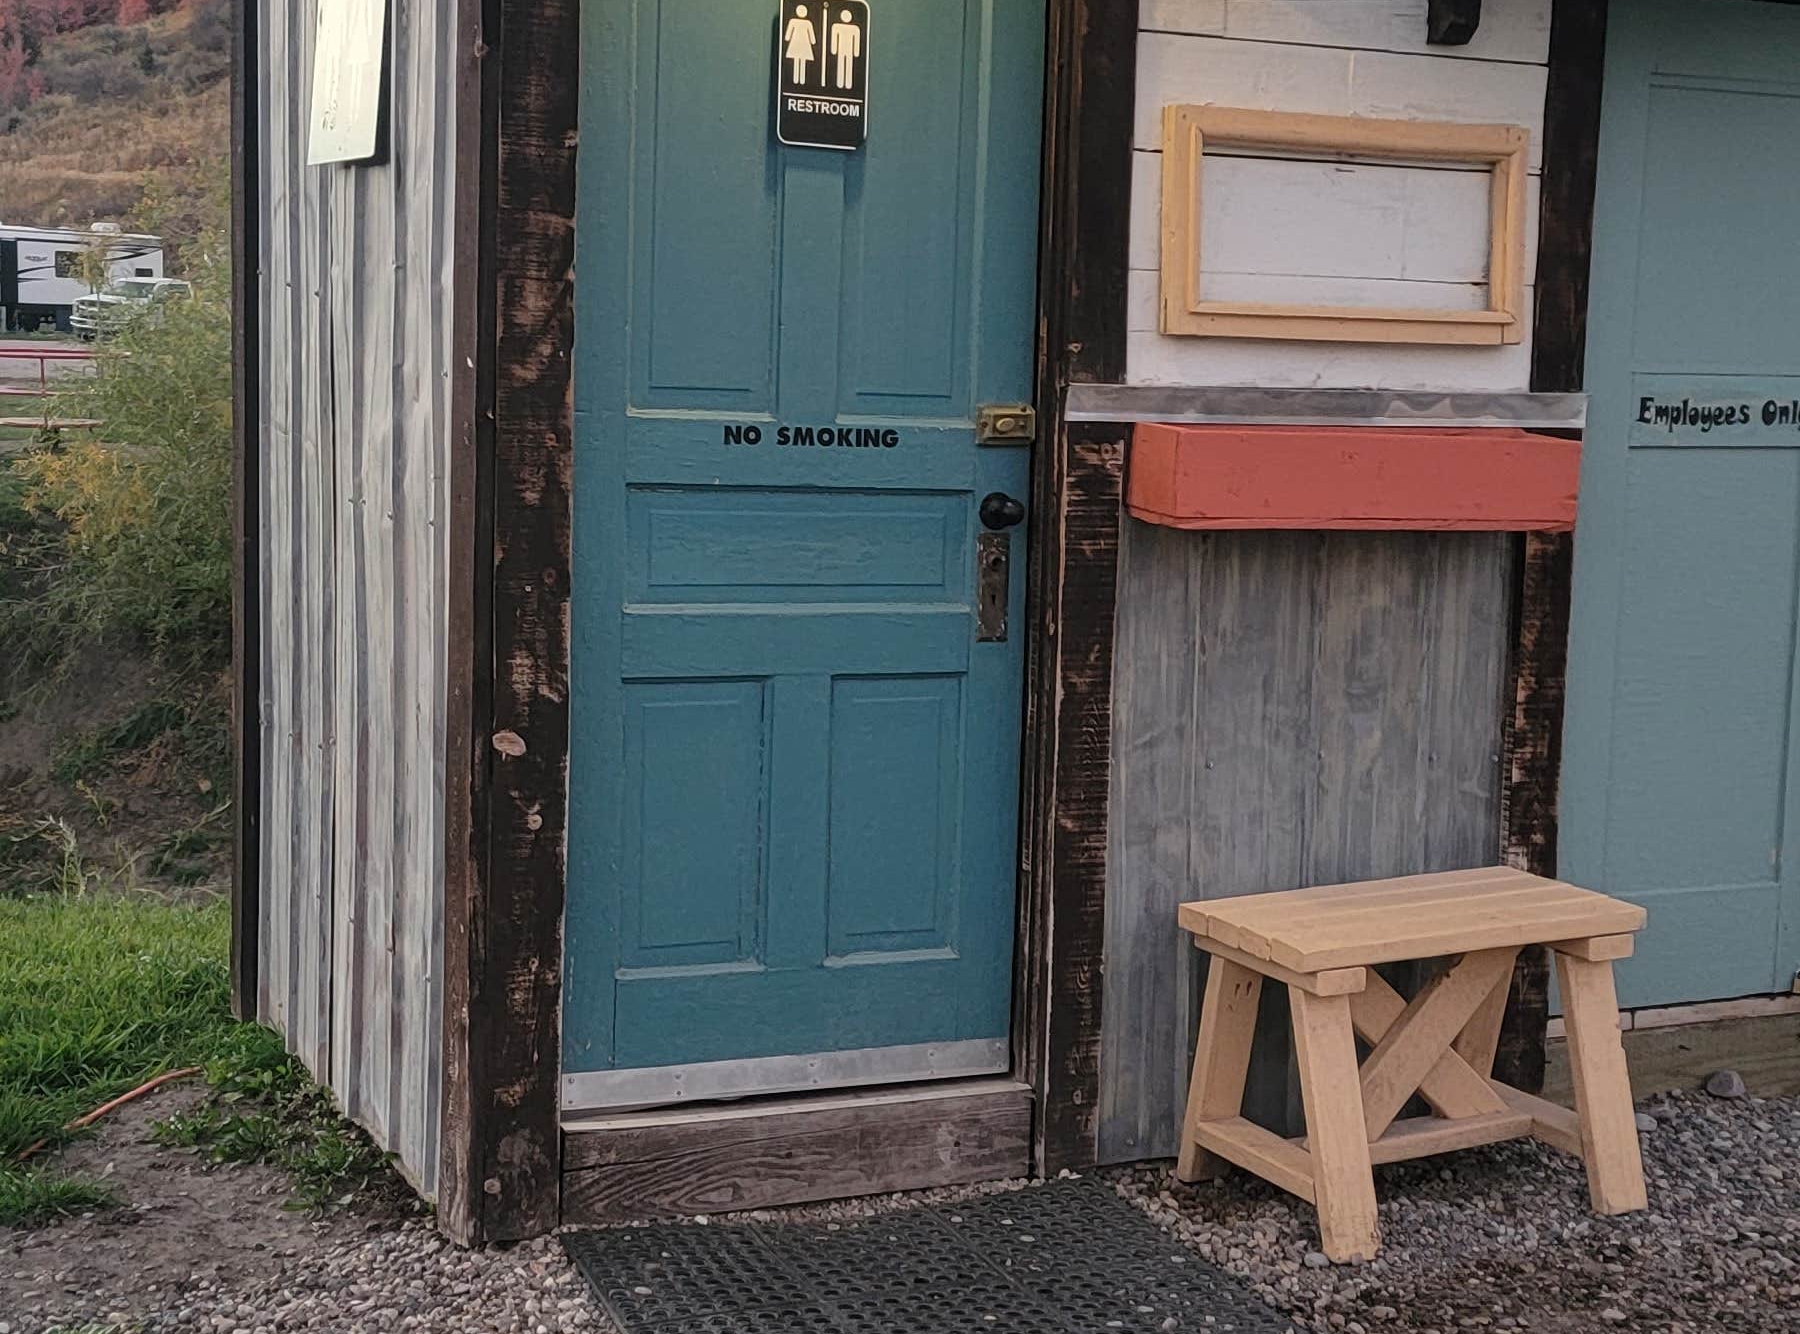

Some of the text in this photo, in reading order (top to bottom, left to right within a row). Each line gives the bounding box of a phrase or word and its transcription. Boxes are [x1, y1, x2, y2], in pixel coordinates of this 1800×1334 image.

[787, 98, 860, 117] RESTROOM
[1636, 396, 1800, 433] Employees Onl
[723, 425, 899, 448] NO SMOKING
